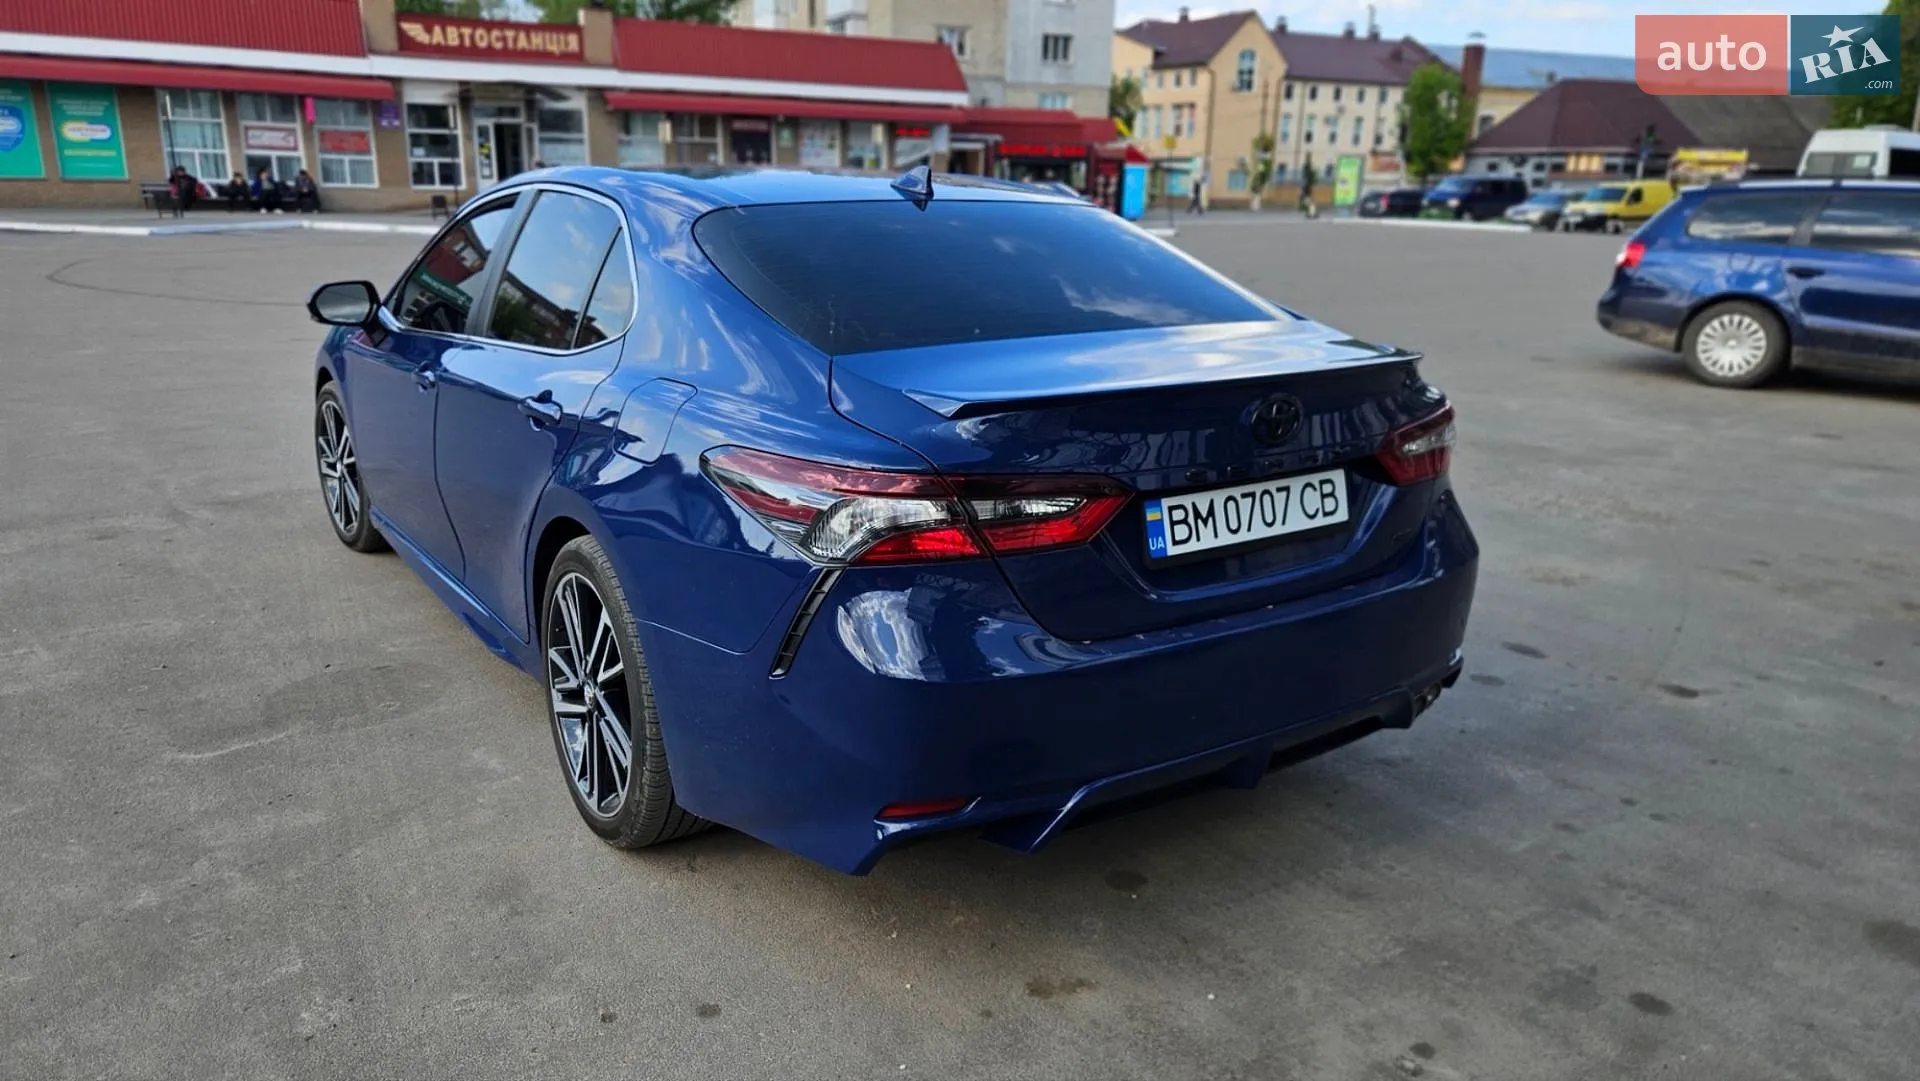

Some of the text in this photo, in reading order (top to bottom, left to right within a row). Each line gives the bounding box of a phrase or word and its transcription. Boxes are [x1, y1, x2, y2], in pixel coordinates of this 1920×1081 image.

[432, 24, 580, 55] АВТОСТАНЦІЯ
[1167, 478, 1339, 546] BM 0707 CB
[1149, 536, 1165, 551] UA
